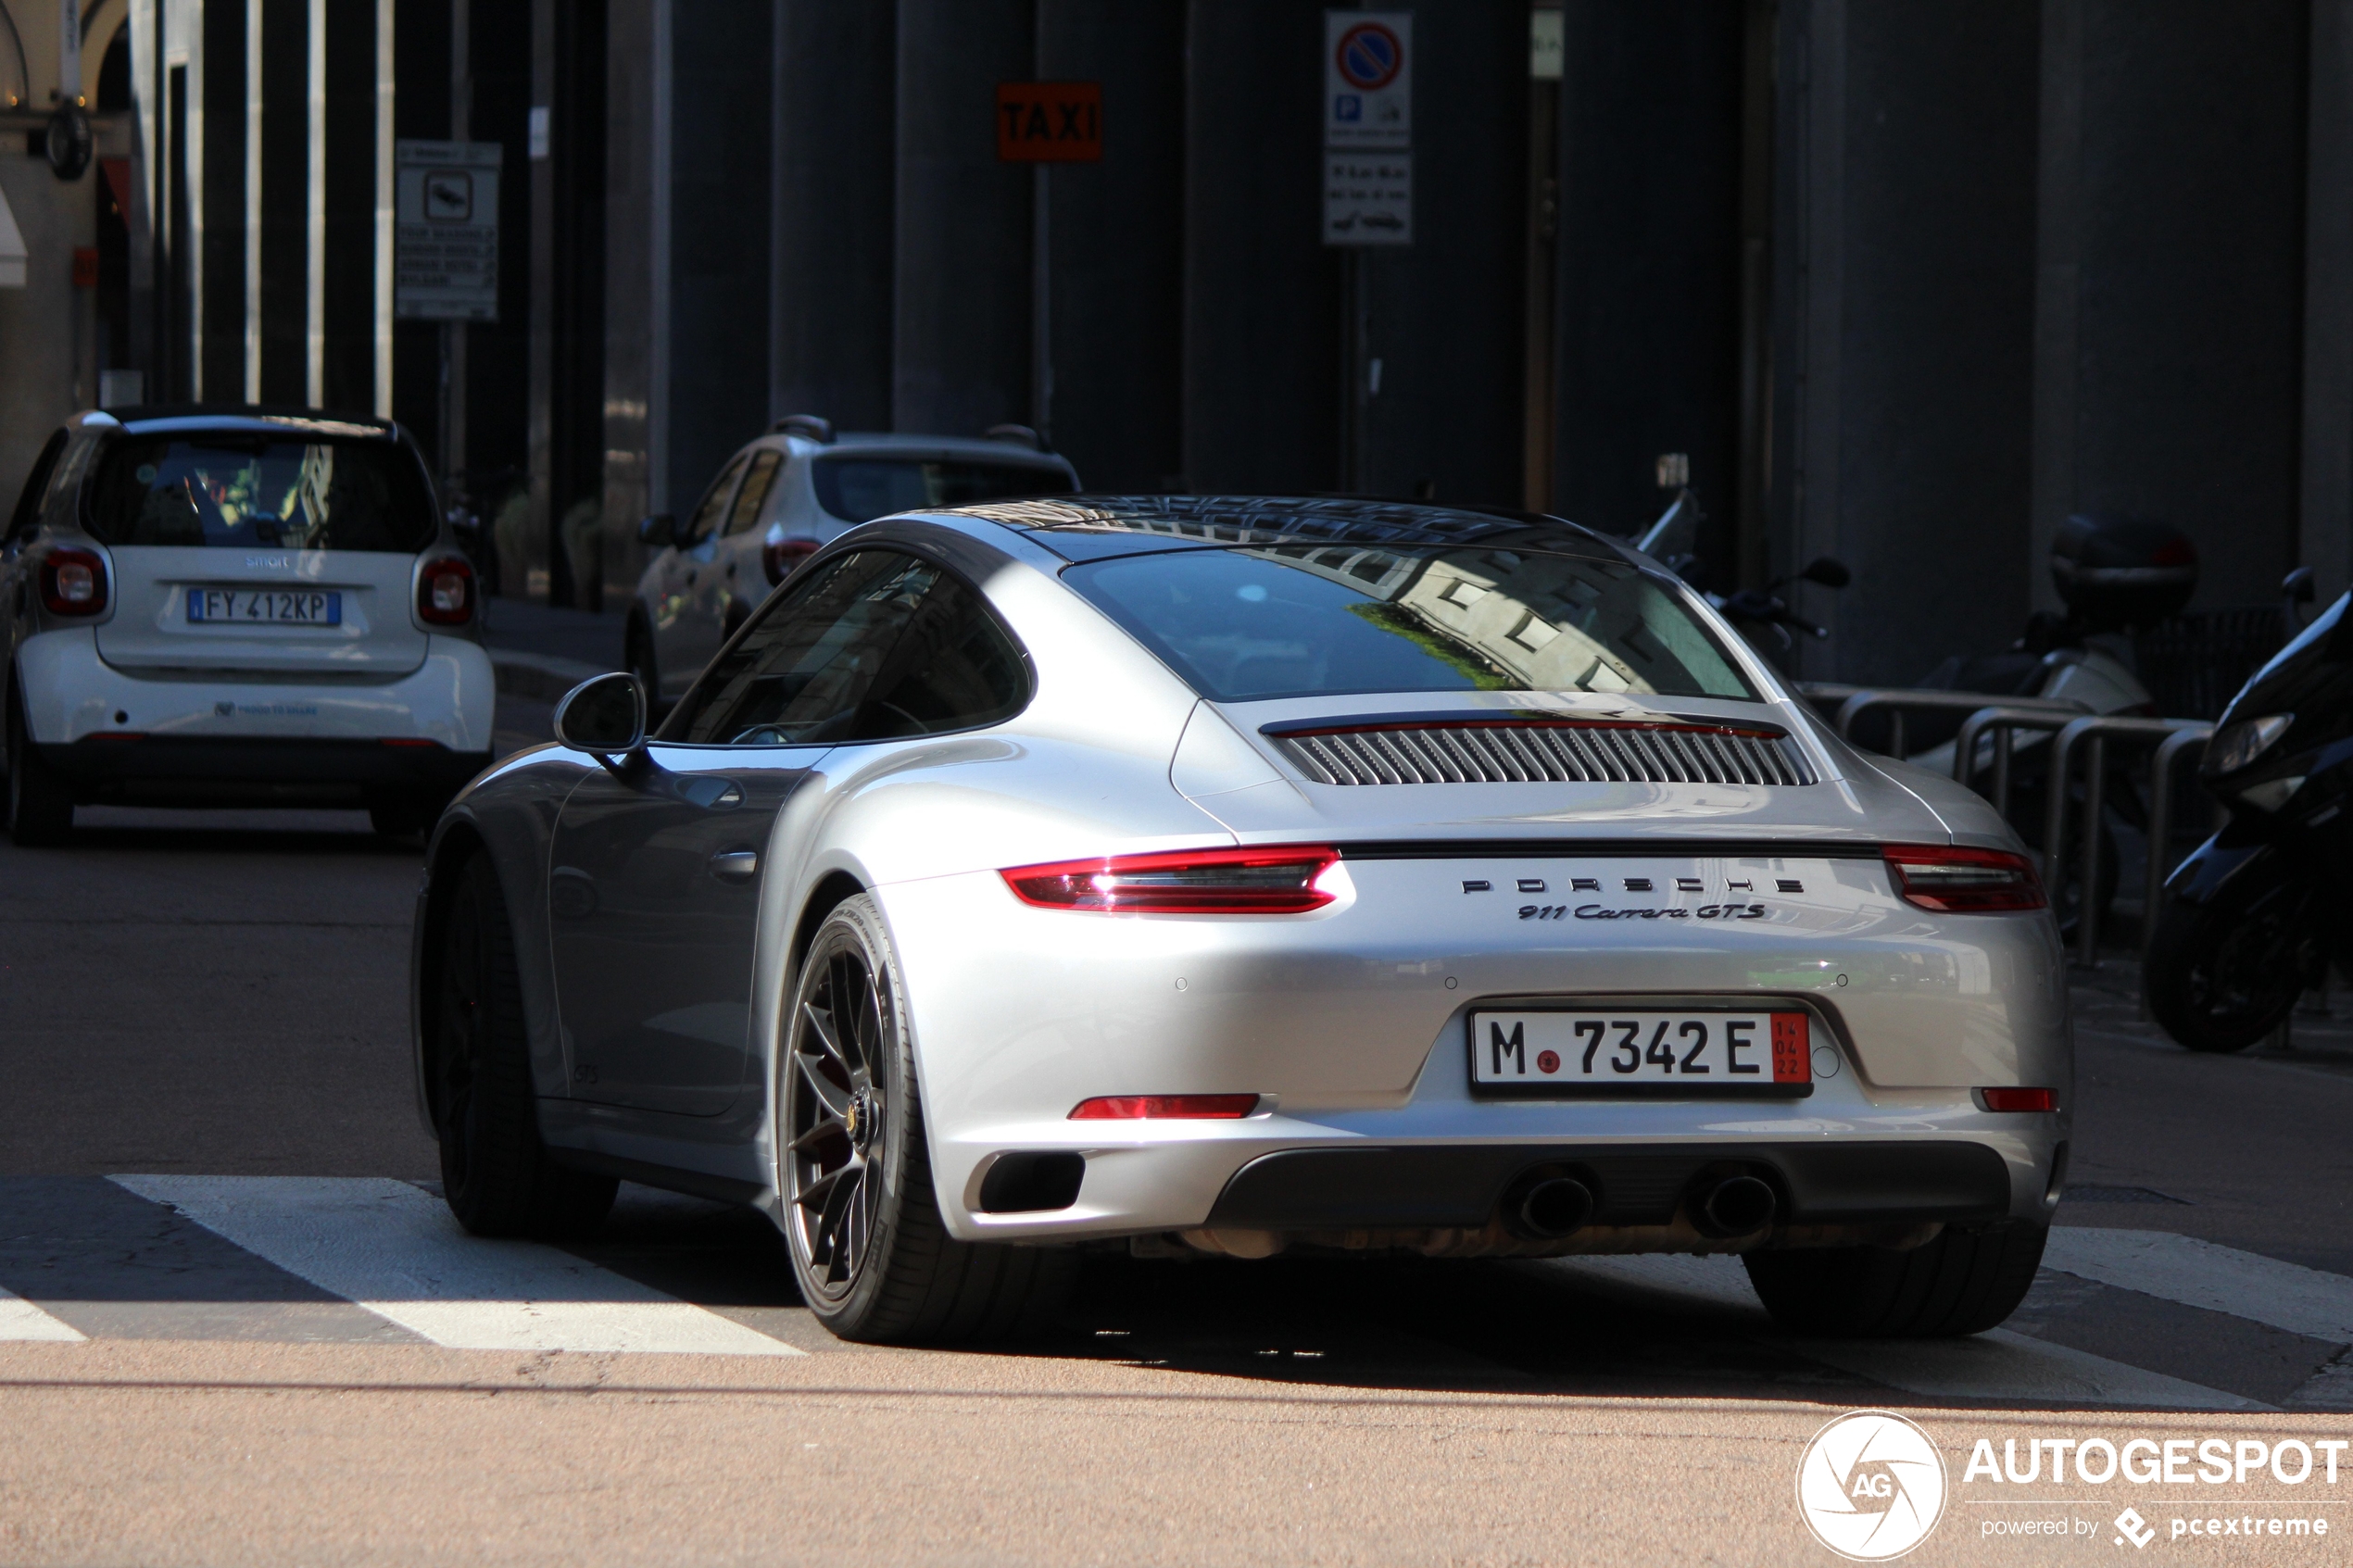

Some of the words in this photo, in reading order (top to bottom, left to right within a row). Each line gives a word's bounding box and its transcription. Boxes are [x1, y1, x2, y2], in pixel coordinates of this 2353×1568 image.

[1002, 101, 1097, 141] TAXI
[245, 557, 289, 568] smart
[207, 592, 236, 618] FY
[246, 593, 324, 620] 412KP
[1461, 877, 1806, 895] PORSCHE
[1518, 904, 1567, 920] 911
[1574, 904, 1690, 920] Carrera
[1696, 904, 1766, 920] GTS
[1776, 1021, 1797, 1036] 14
[1491, 1021, 1526, 1075] M
[1574, 1021, 1710, 1074] 7342
[1726, 1021, 1760, 1074] E
[1776, 1039, 1797, 1056] 04
[1777, 1059, 1799, 1074] 22
